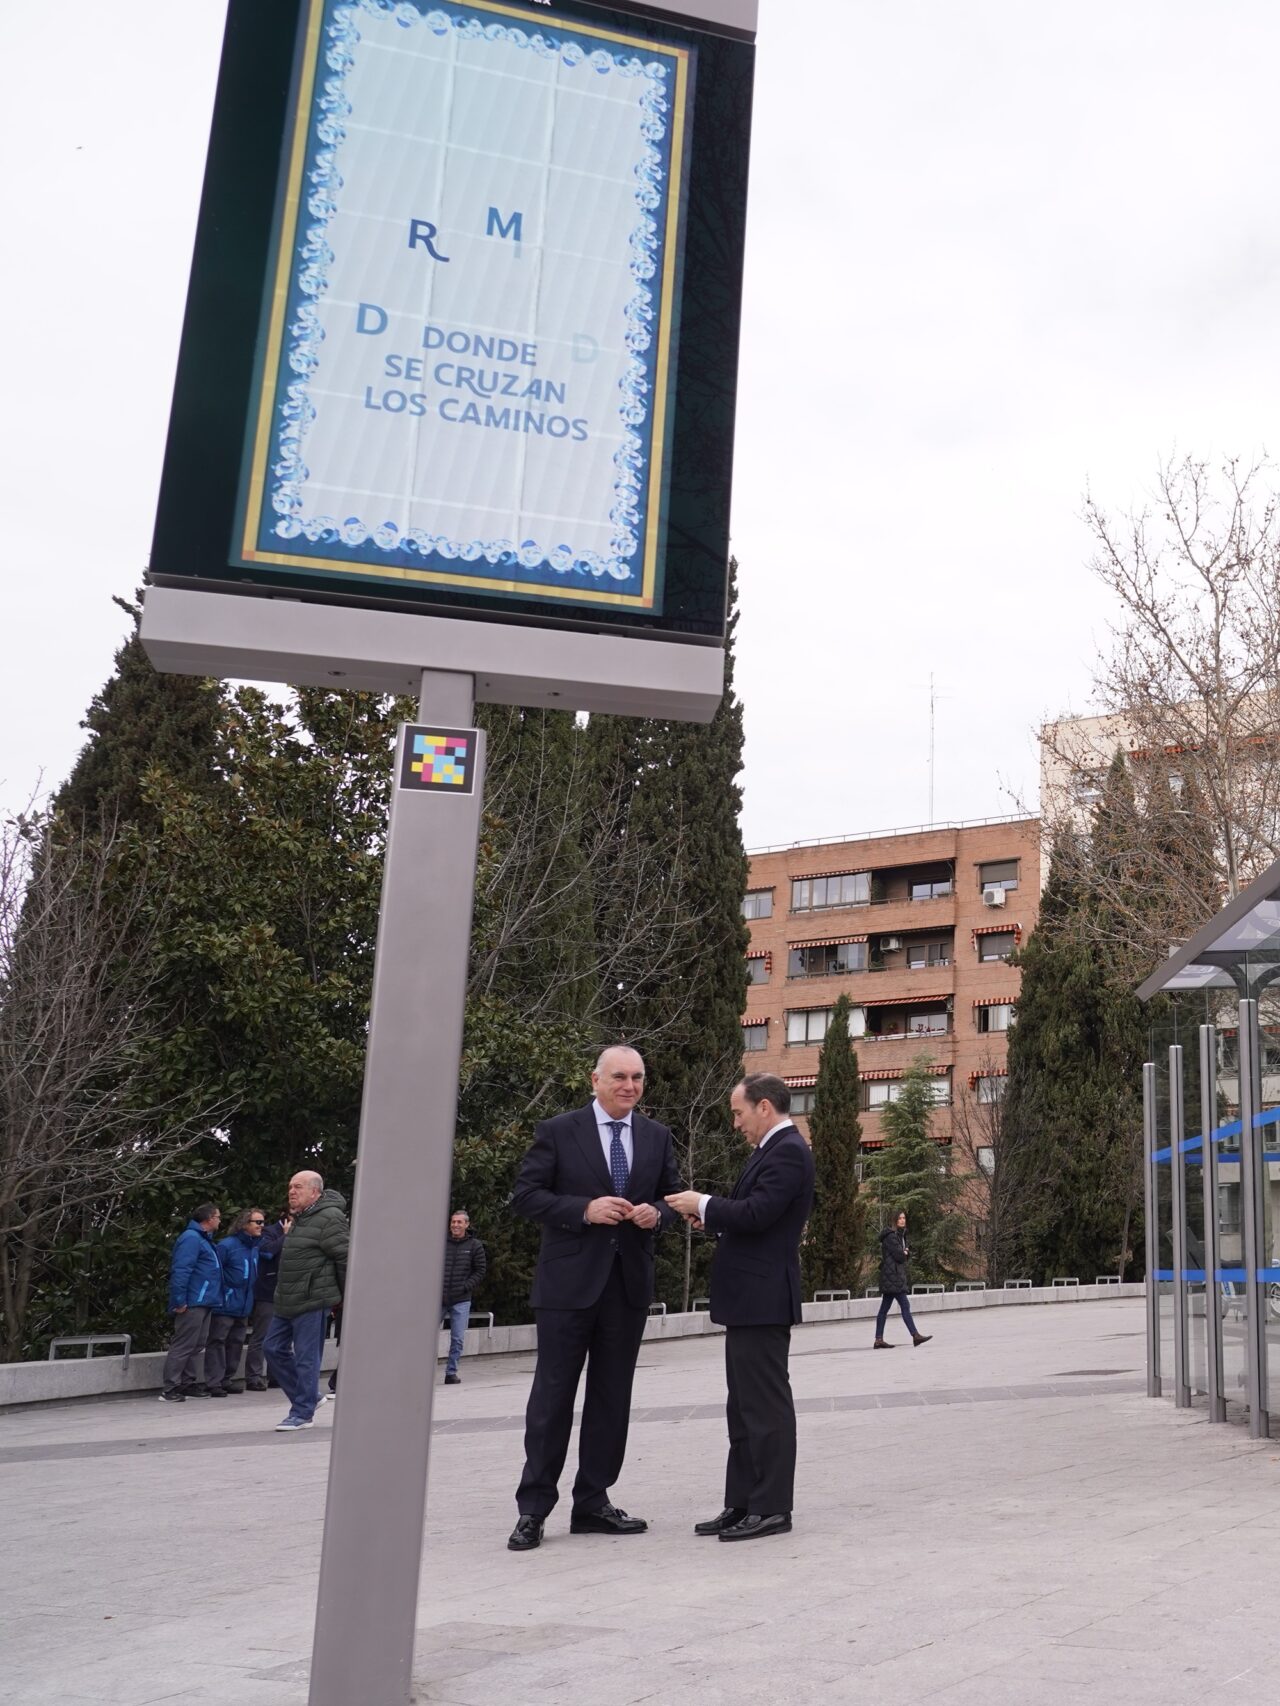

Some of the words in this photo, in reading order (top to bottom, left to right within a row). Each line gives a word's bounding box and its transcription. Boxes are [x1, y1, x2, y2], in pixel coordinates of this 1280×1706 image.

[422, 326, 538, 367] DONDE
[384, 354, 424, 382] SE
[433, 363, 566, 404] CRUZAN
[364, 386, 428, 417] LOS
[438, 398, 589, 442] CAMINOS
